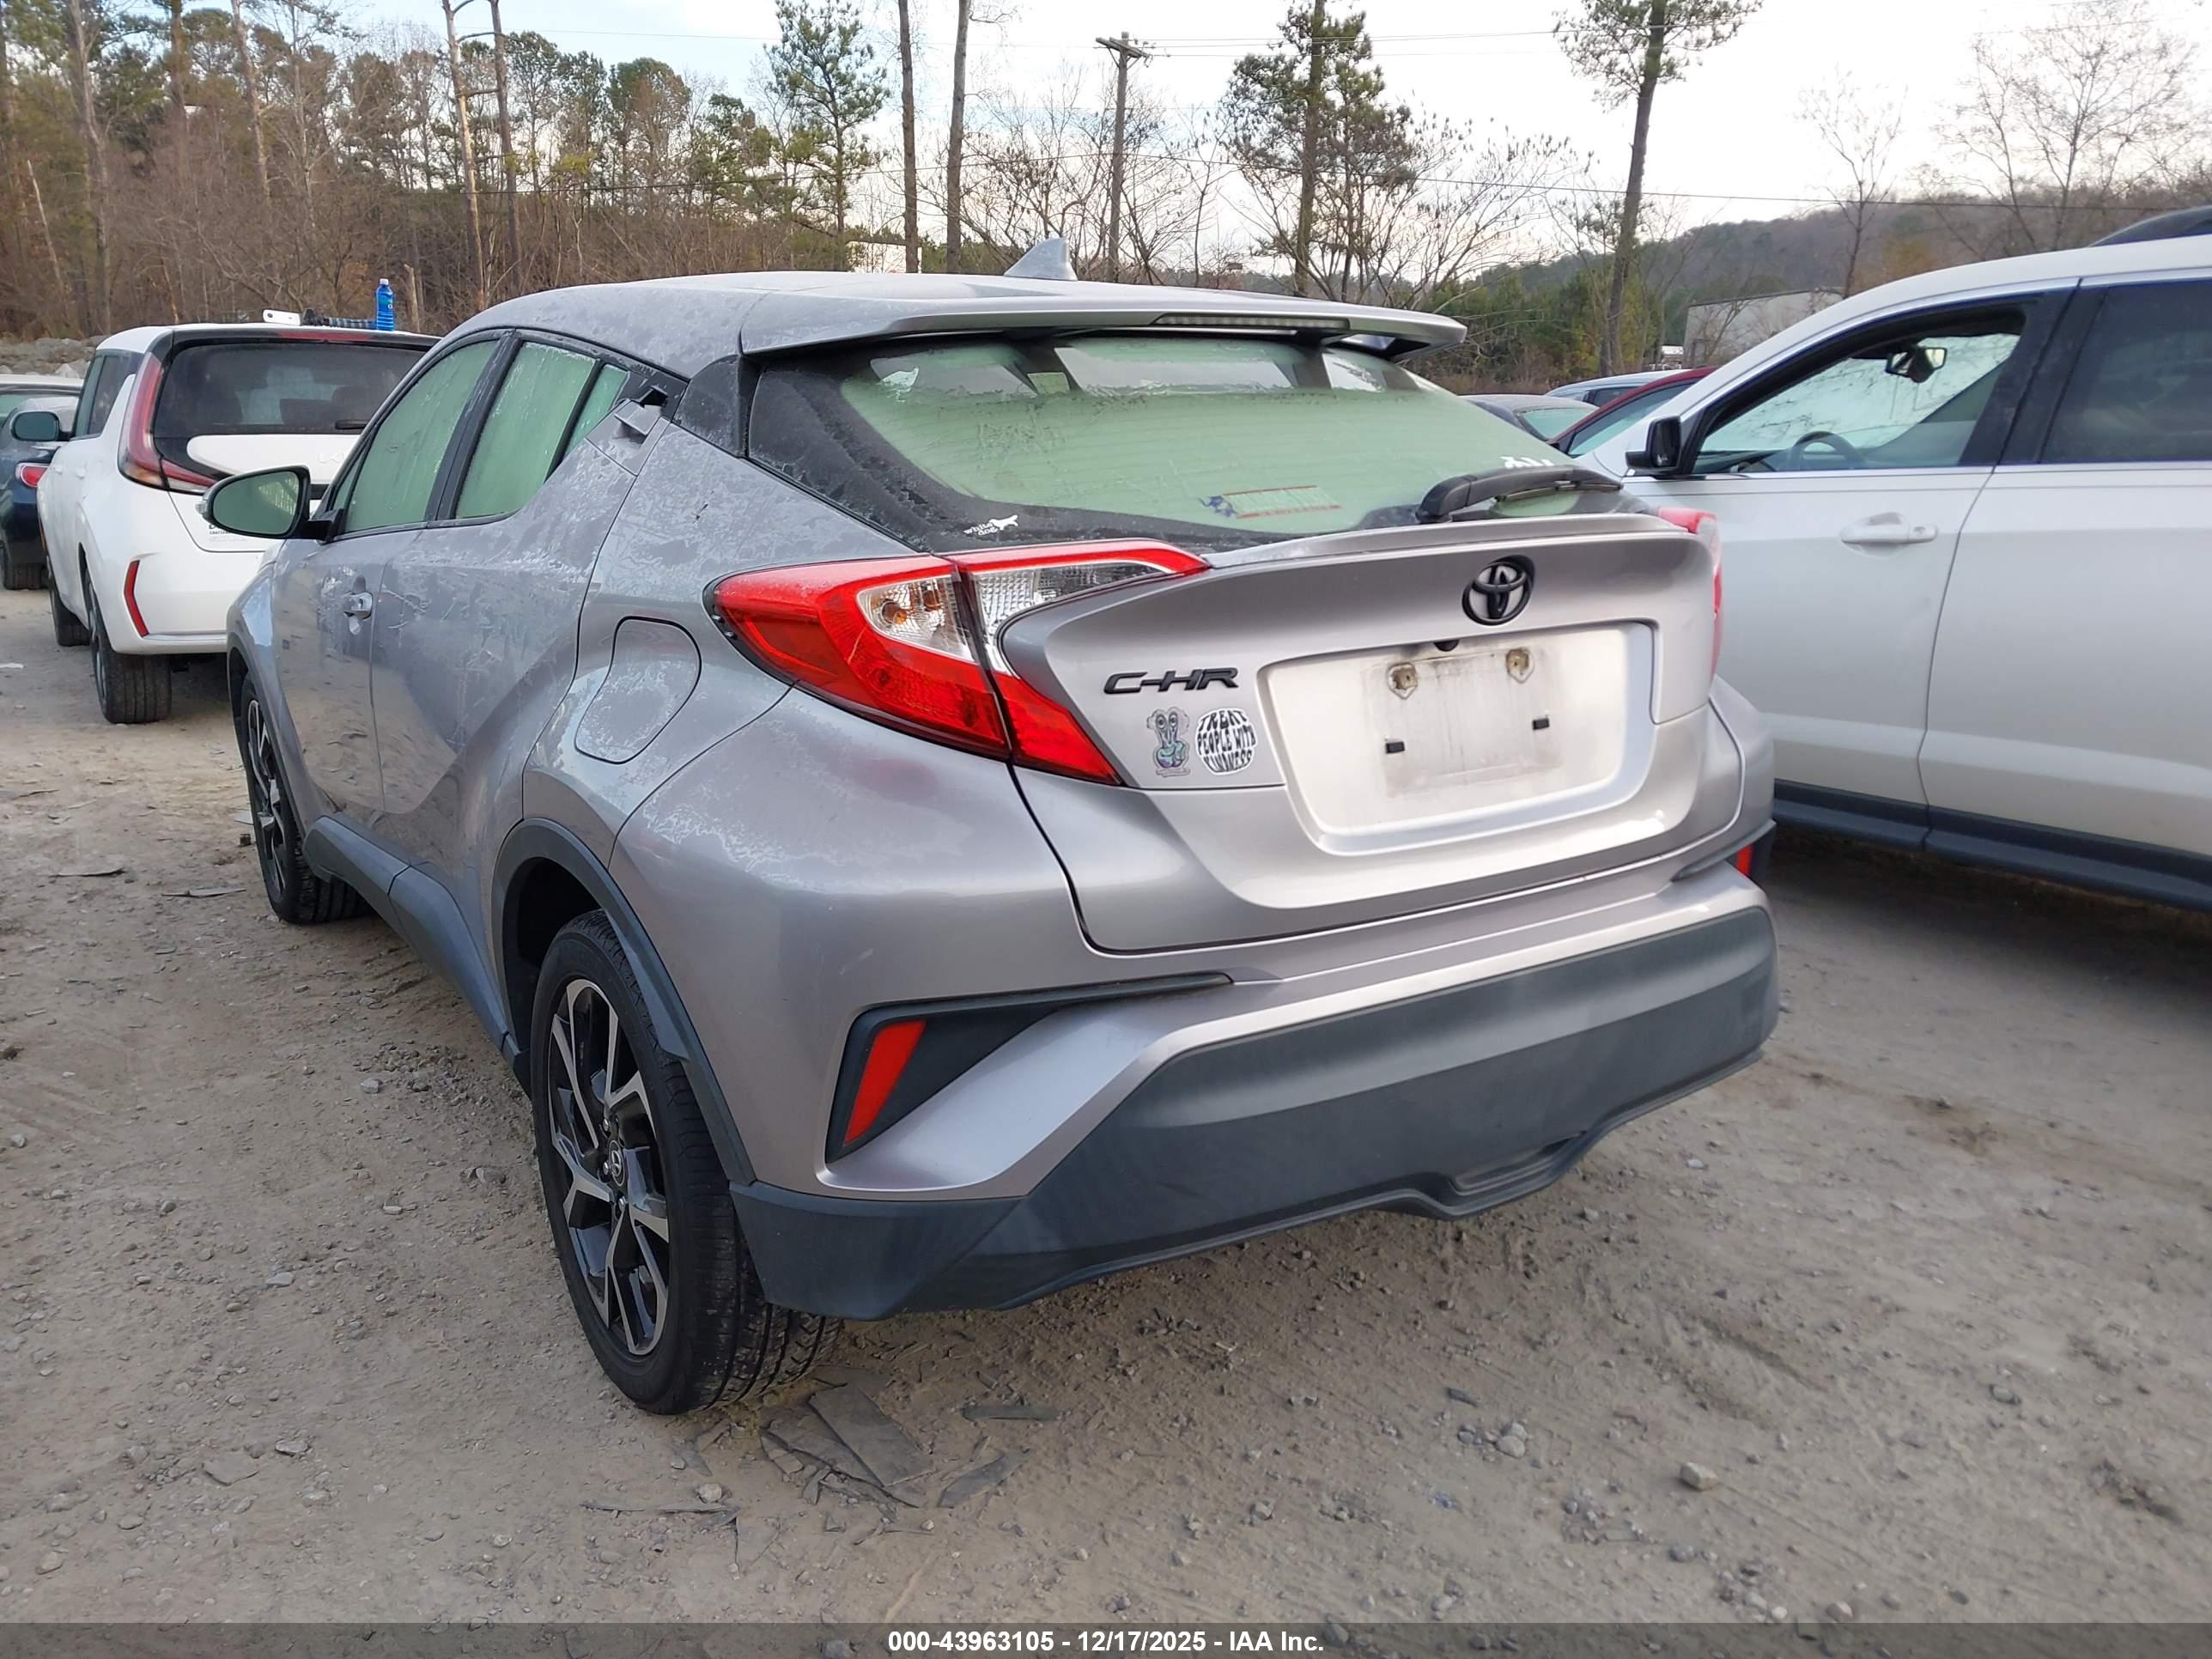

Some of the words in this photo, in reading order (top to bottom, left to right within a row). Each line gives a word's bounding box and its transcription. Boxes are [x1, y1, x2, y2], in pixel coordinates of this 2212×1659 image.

[1103, 667, 1239, 695] C-HR
[1198, 709, 1248, 732] TREAT
[1197, 728, 1233, 756] PEOPLE
[1232, 725, 1256, 750] WITH
[1202, 749, 1253, 772] KINDNESS
